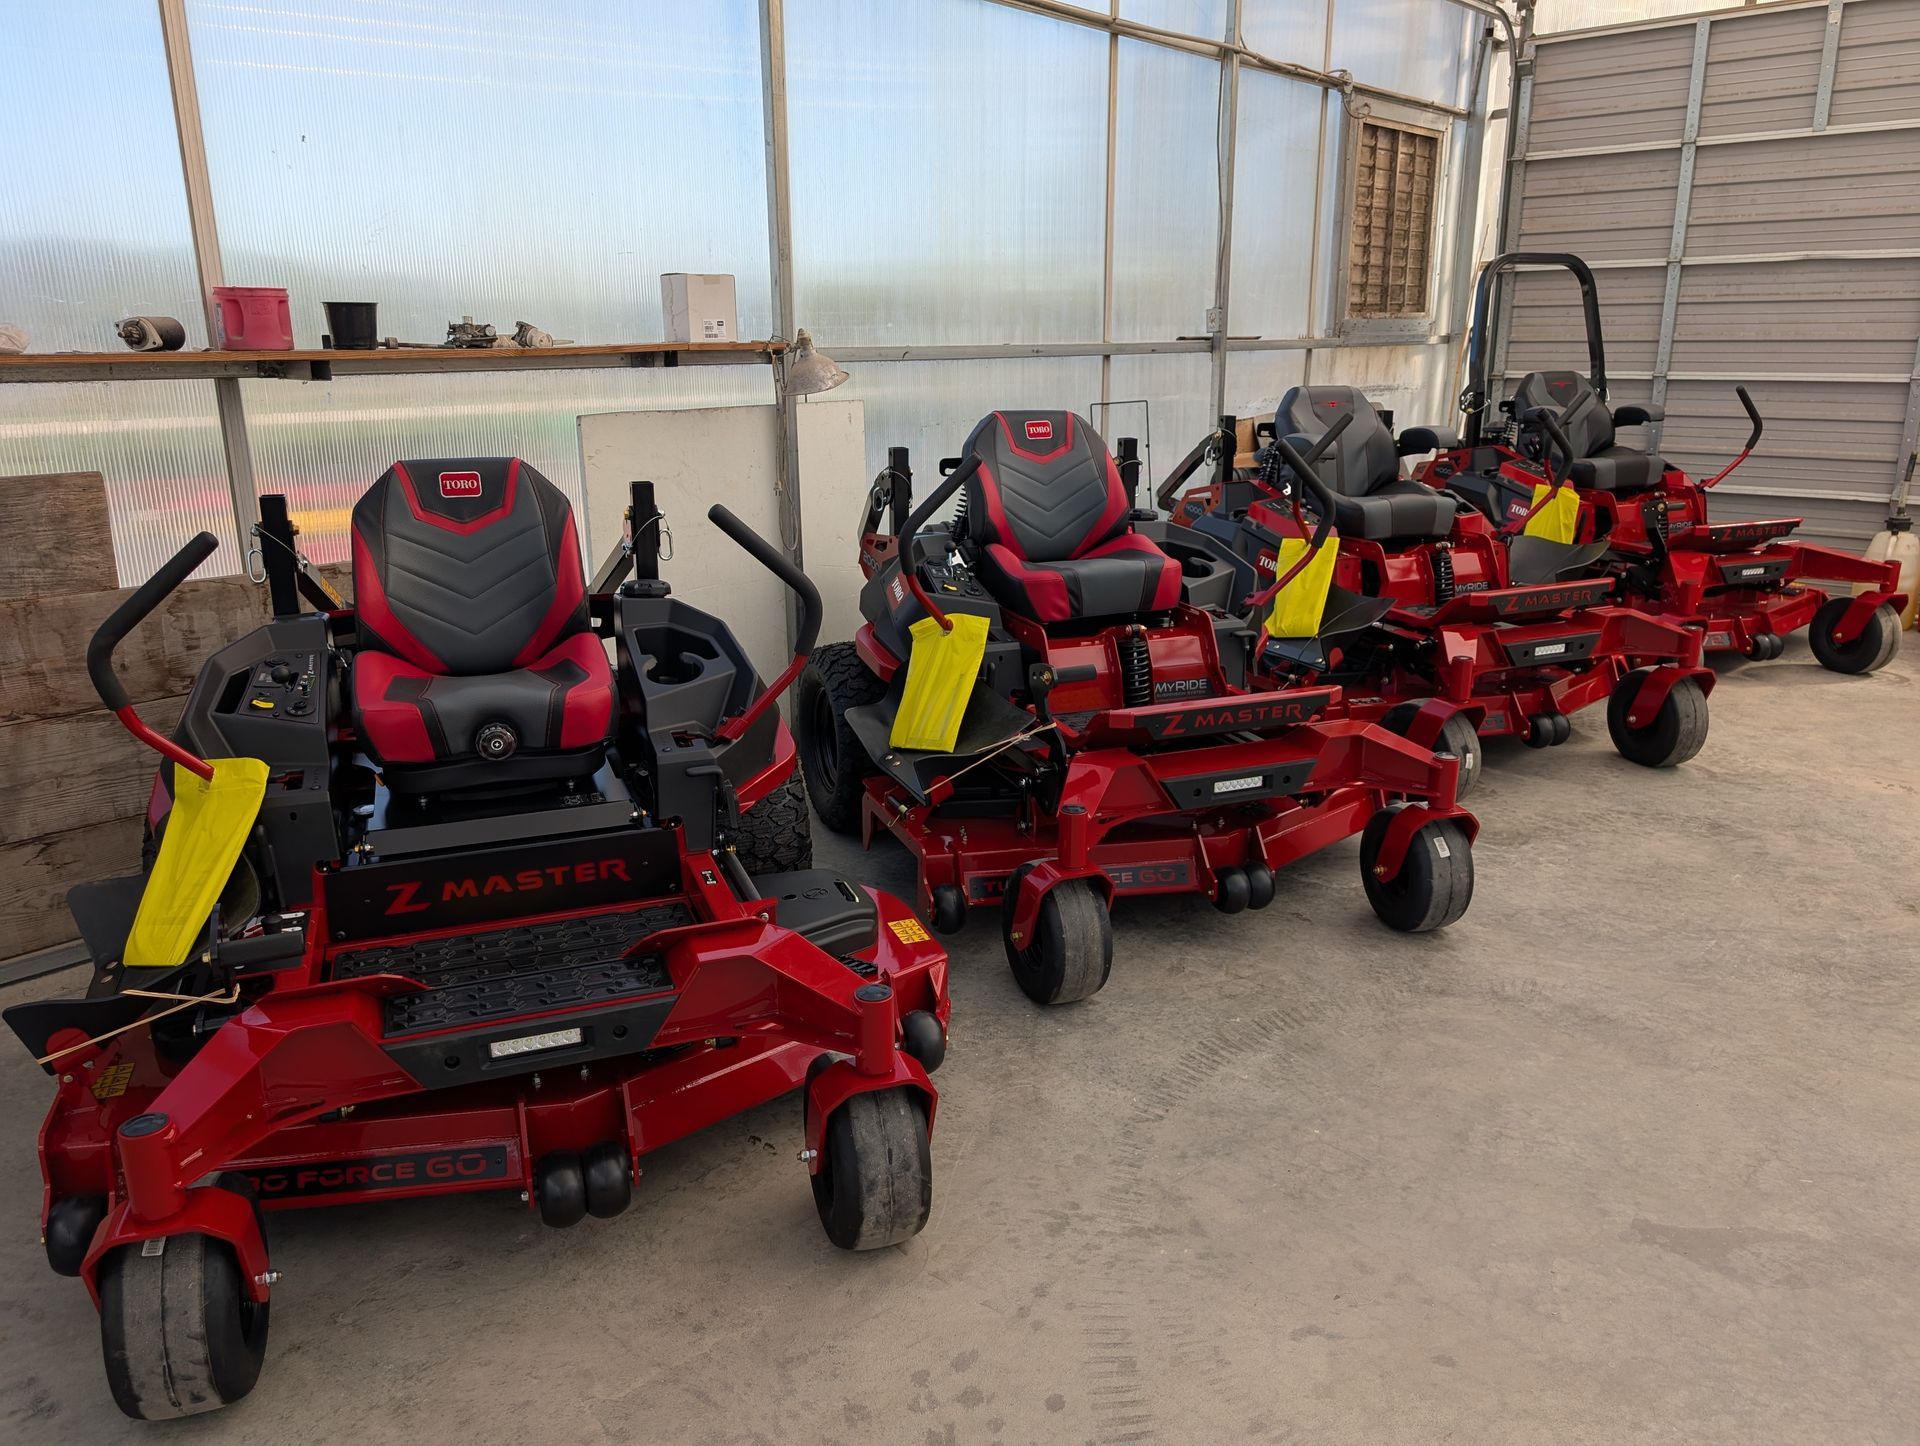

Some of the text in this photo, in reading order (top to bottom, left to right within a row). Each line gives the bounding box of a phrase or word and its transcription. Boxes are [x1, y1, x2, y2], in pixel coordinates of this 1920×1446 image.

[1028, 426, 1050, 434] TORO
[442, 479, 478, 490] TORO
[1510, 503, 1529, 517] TOR
[1721, 525, 1788, 541] Z MASTER
[1259, 555, 1278, 573] TOR
[891, 576, 904, 604] TORO
[1503, 589, 1593, 613] Z MASTER
[1161, 703, 1303, 737] Z MASTER
[384, 858, 633, 916] Z MASTER
[297, 1161, 416, 1190] FORCE
